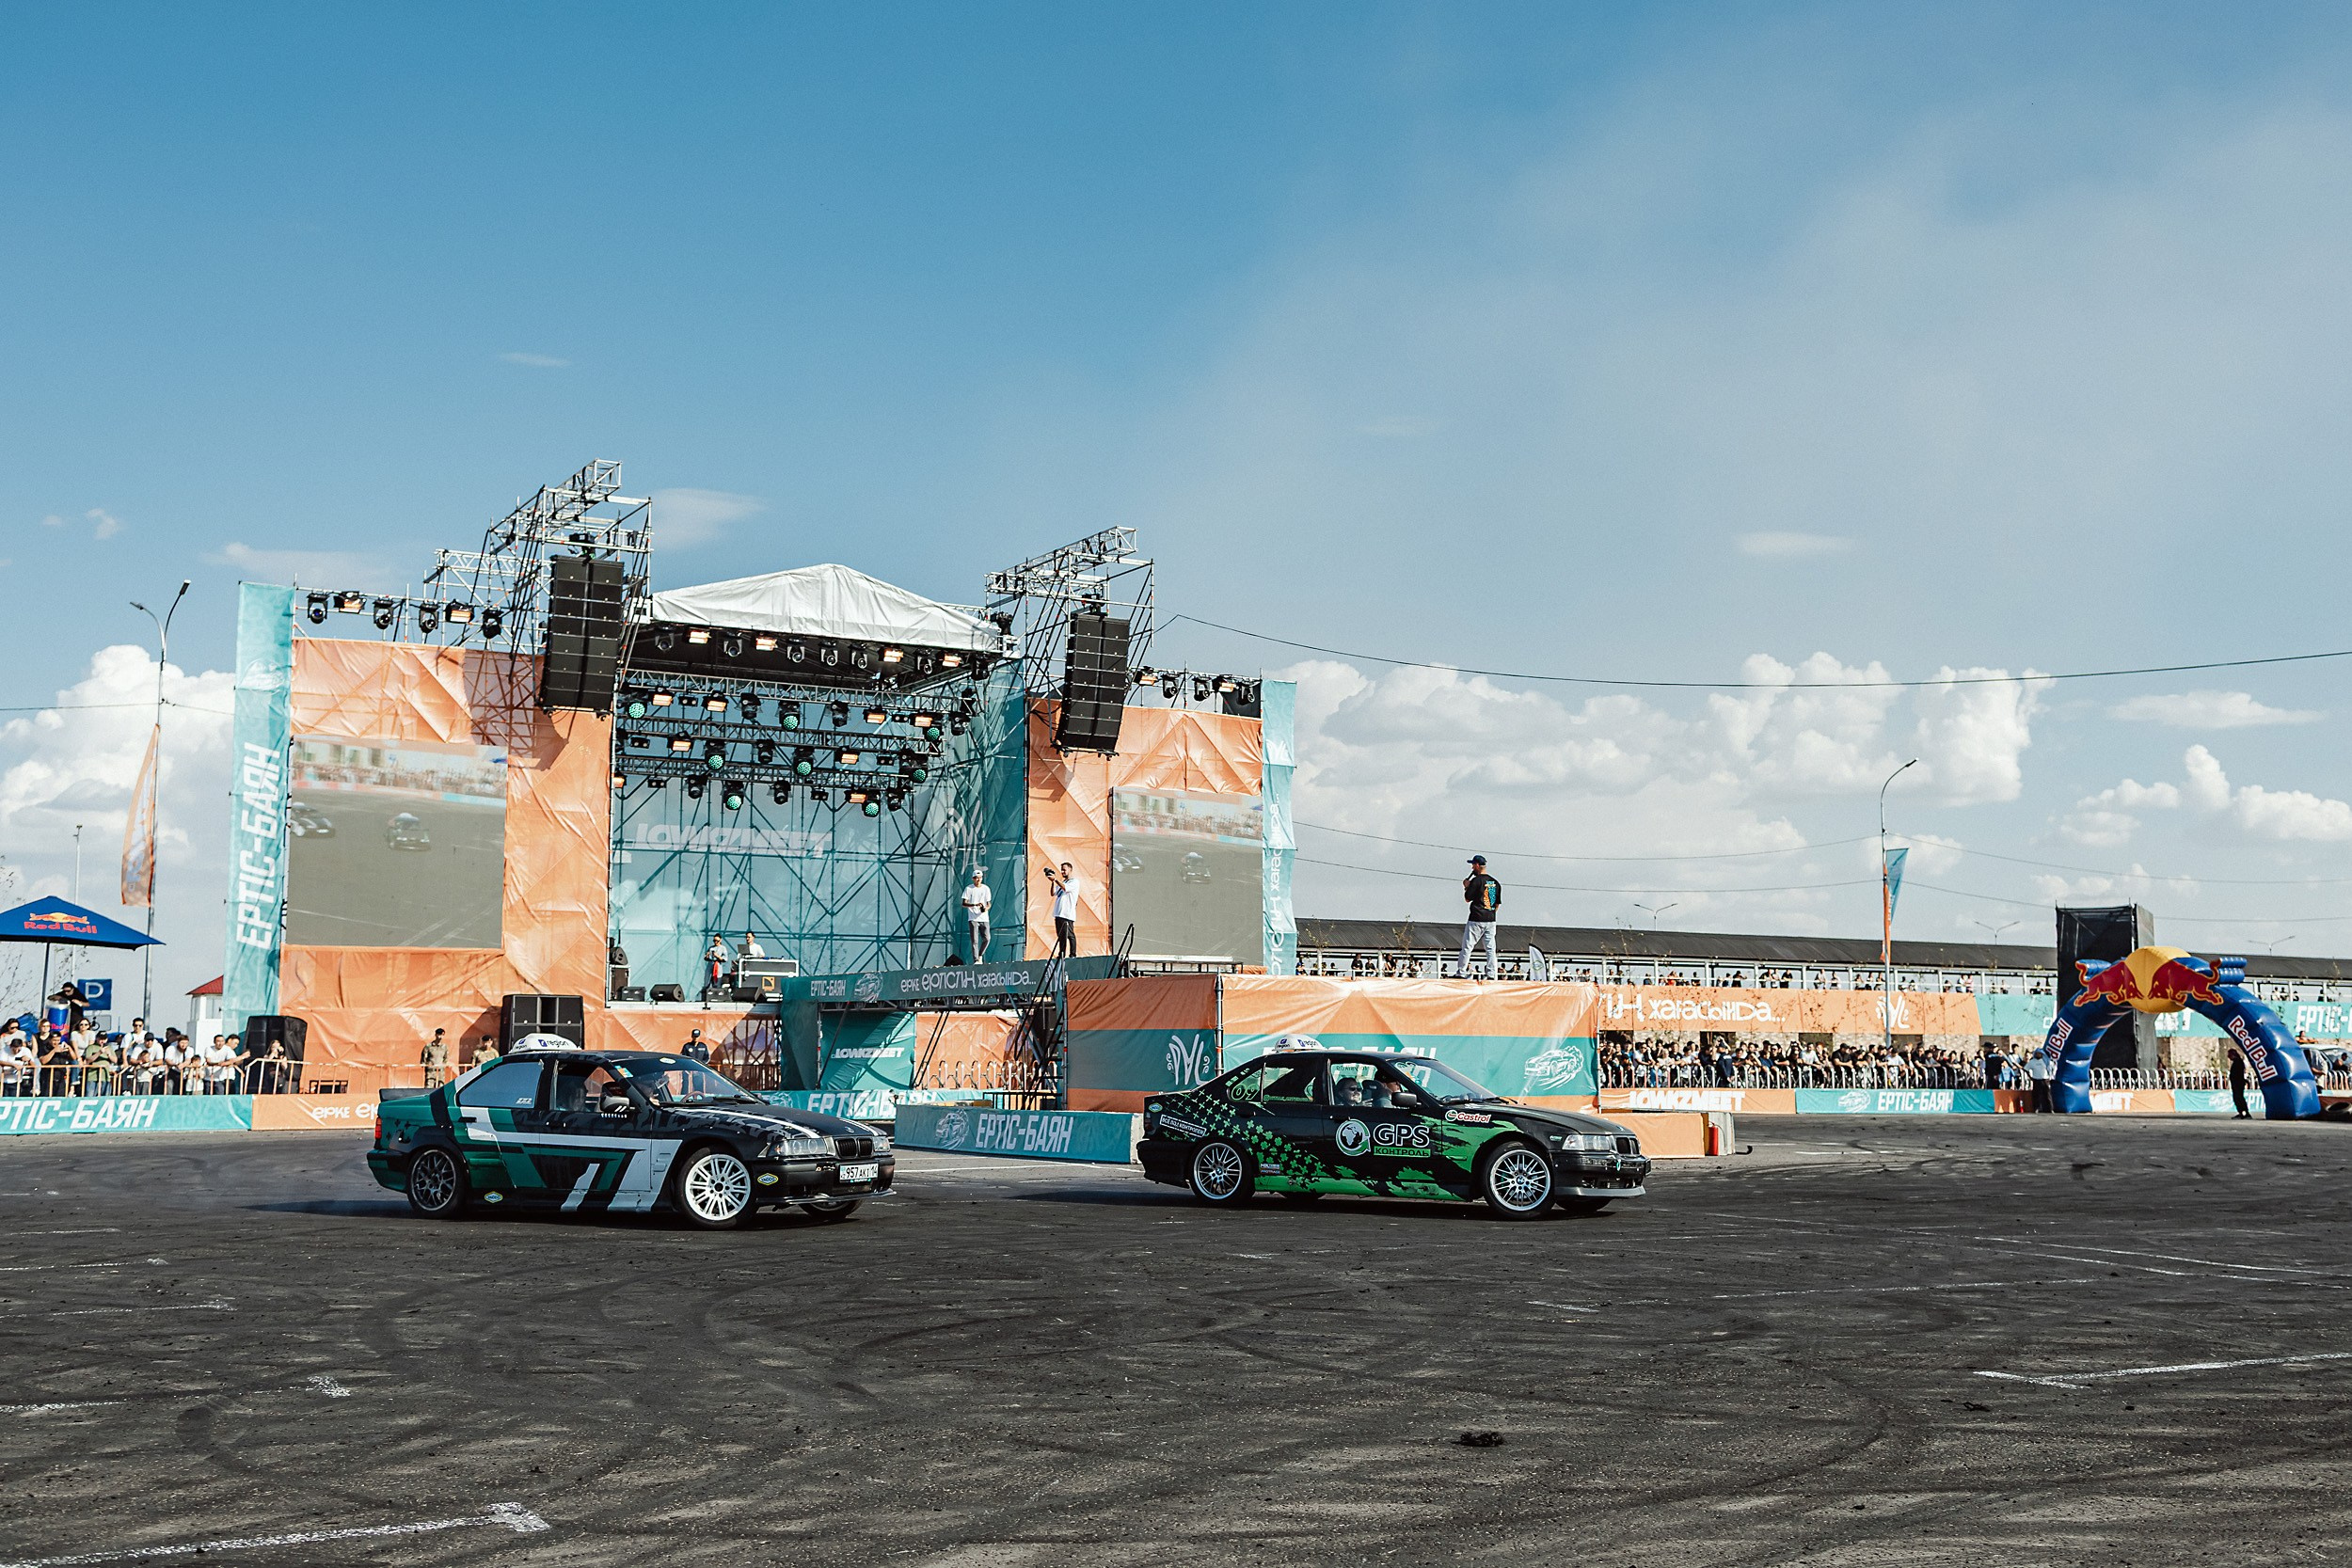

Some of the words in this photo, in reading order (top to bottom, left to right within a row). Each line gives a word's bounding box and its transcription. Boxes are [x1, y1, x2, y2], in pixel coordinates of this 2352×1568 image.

[63, 924, 98, 934] Bull
[2296, 1006, 2352, 1035] ЕРТІС-
[2048, 1017, 2074, 1051] Bull
[2228, 1015, 2260, 1052] Red
[2249, 1045, 2278, 1082] Bull
[1878, 1091, 1954, 1111] ЕРТІС-БАЯН
[1457, 1112, 1491, 1123] Castrol
[975, 1113, 1074, 1153] ЕРТІС-БАЯН
[1374, 1123, 1429, 1148] GPS
[1375, 1148, 1429, 1157] КОНТРОЛЬ
